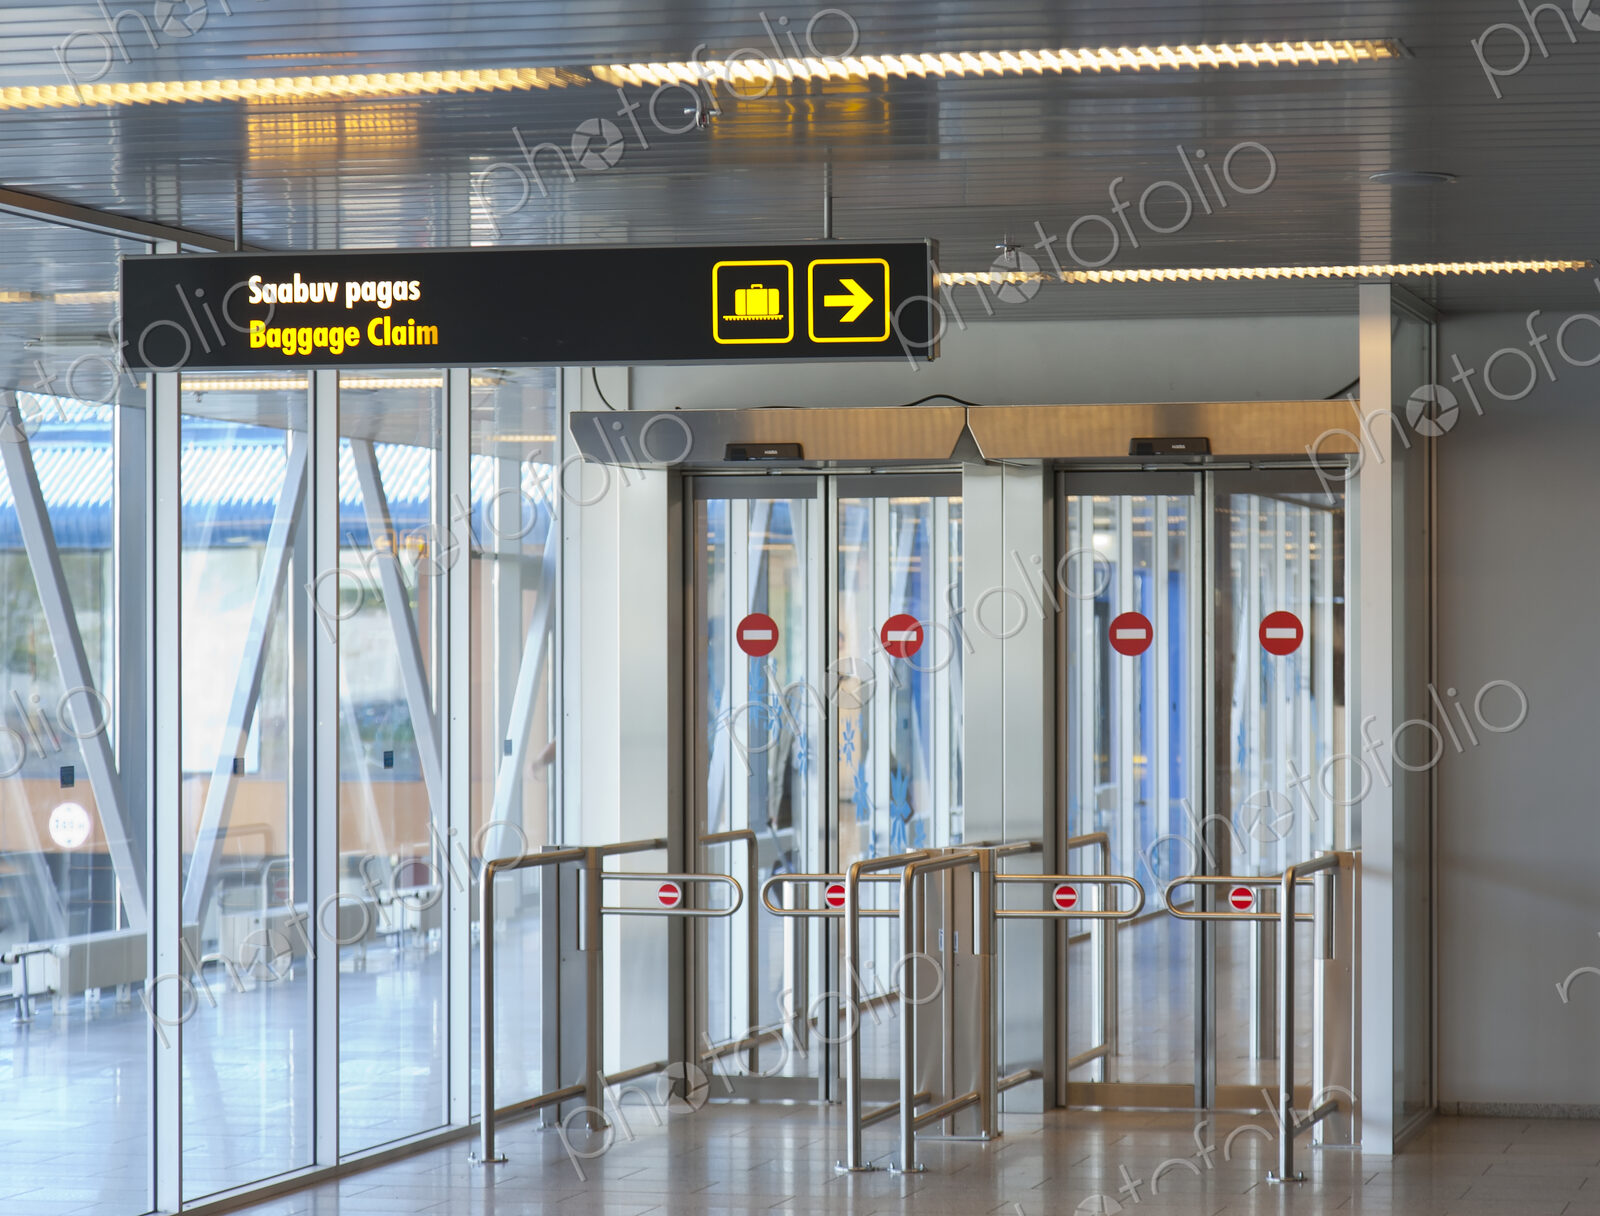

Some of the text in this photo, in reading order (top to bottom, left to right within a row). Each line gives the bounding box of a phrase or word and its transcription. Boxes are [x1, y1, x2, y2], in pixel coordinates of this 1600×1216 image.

[248, 272, 421, 309] Saabuv pagas
[249, 315, 439, 356] Baggage Claim
